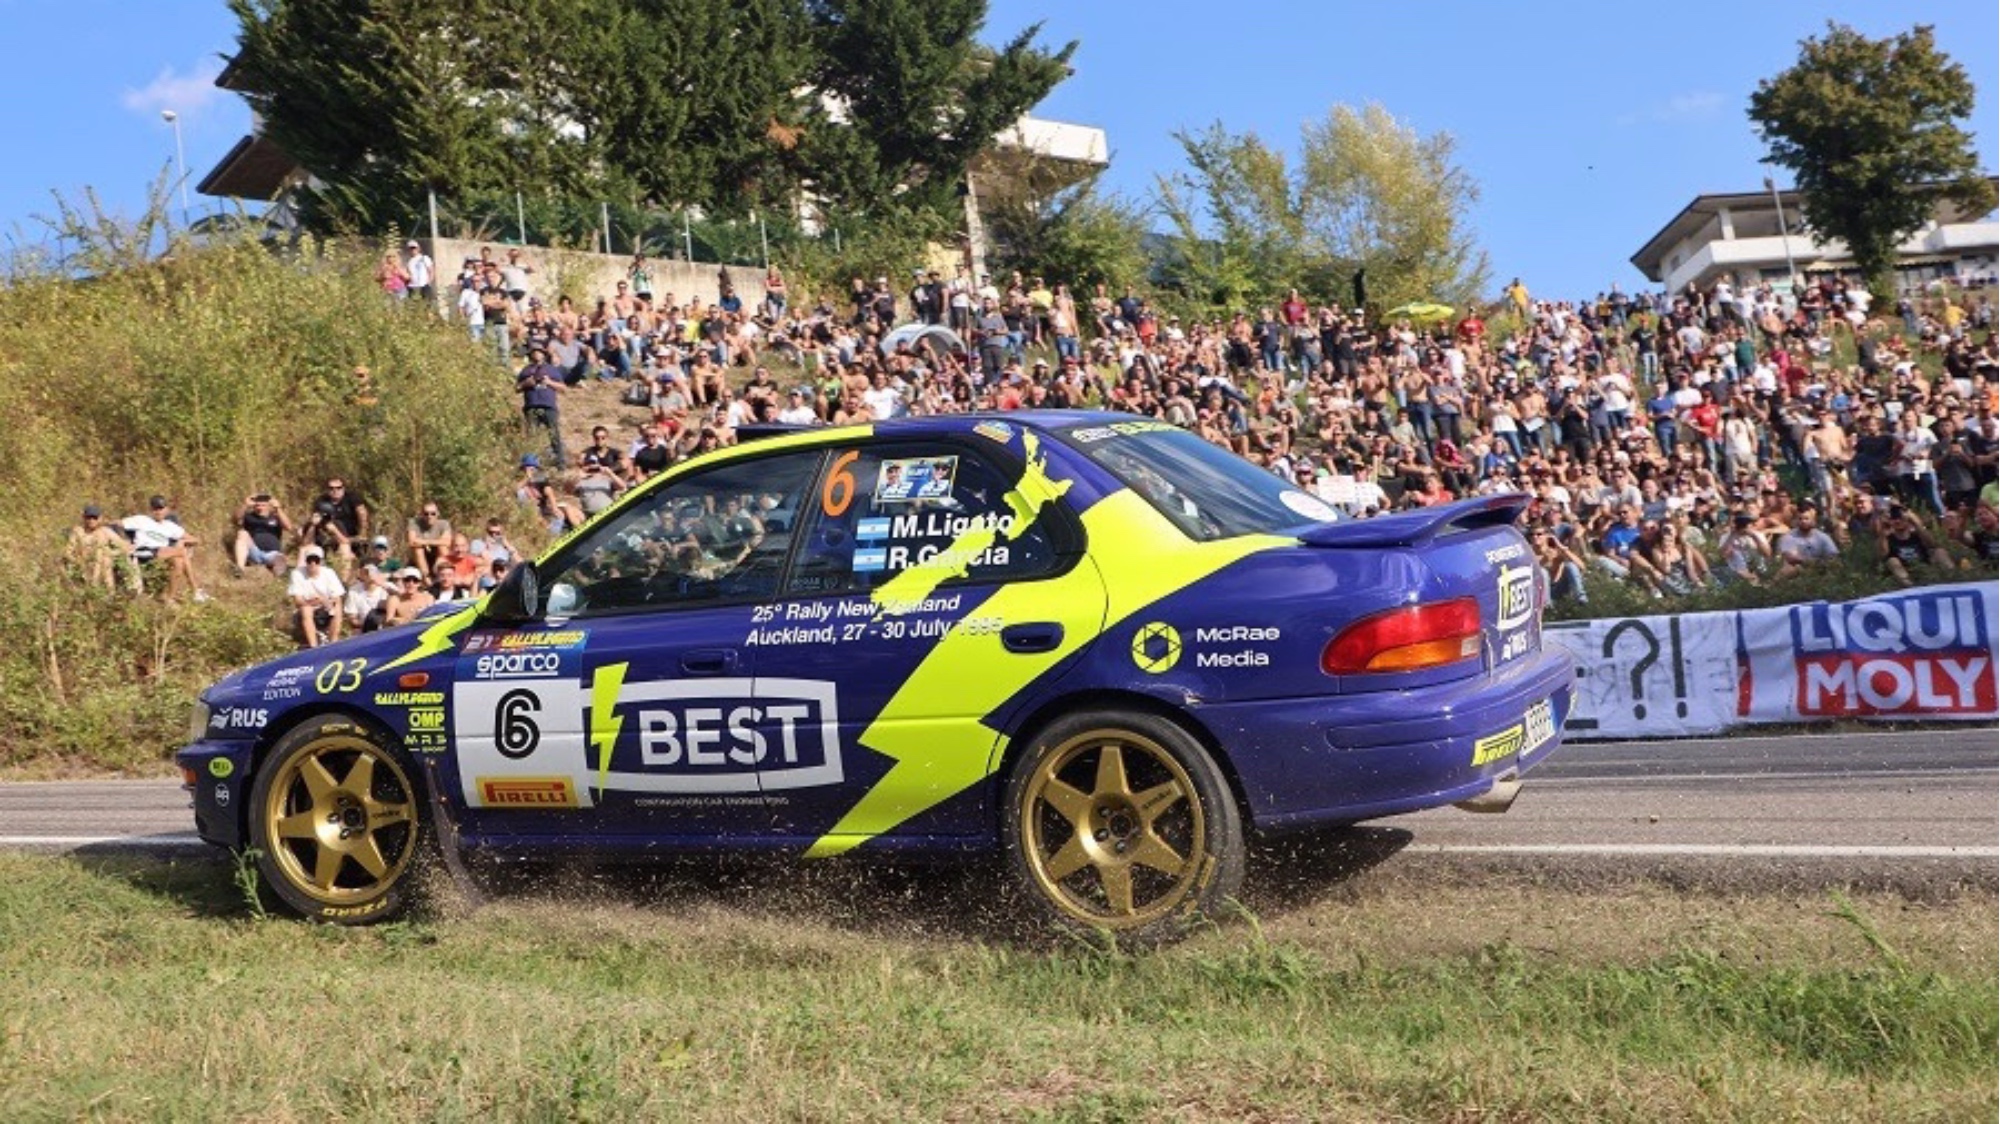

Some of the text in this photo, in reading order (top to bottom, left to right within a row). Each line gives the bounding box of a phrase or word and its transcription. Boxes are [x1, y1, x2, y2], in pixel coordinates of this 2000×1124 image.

[823, 450, 861, 516] 6
[785, 603, 834, 622] Rally
[836, 600, 878, 619] New
[881, 595, 962, 616] Zland
[744, 626, 837, 647] Auckland,
[842, 624, 866, 641] 27
[881, 621, 905, 639] 30
[910, 619, 952, 641] July
[1196, 626, 1280, 643] McRae
[1801, 596, 1979, 654] LIQUI
[476, 652, 560, 681] sparco
[1196, 650, 1270, 667] Media
[315, 657, 368, 694] 03
[1805, 657, 1988, 710] MOLY
[263, 687, 301, 701] EDITION
[408, 712, 445, 729] OMP
[494, 688, 542, 760] 6
[638, 704, 809, 766] BEST
[484, 781, 568, 804] PIRELLI
